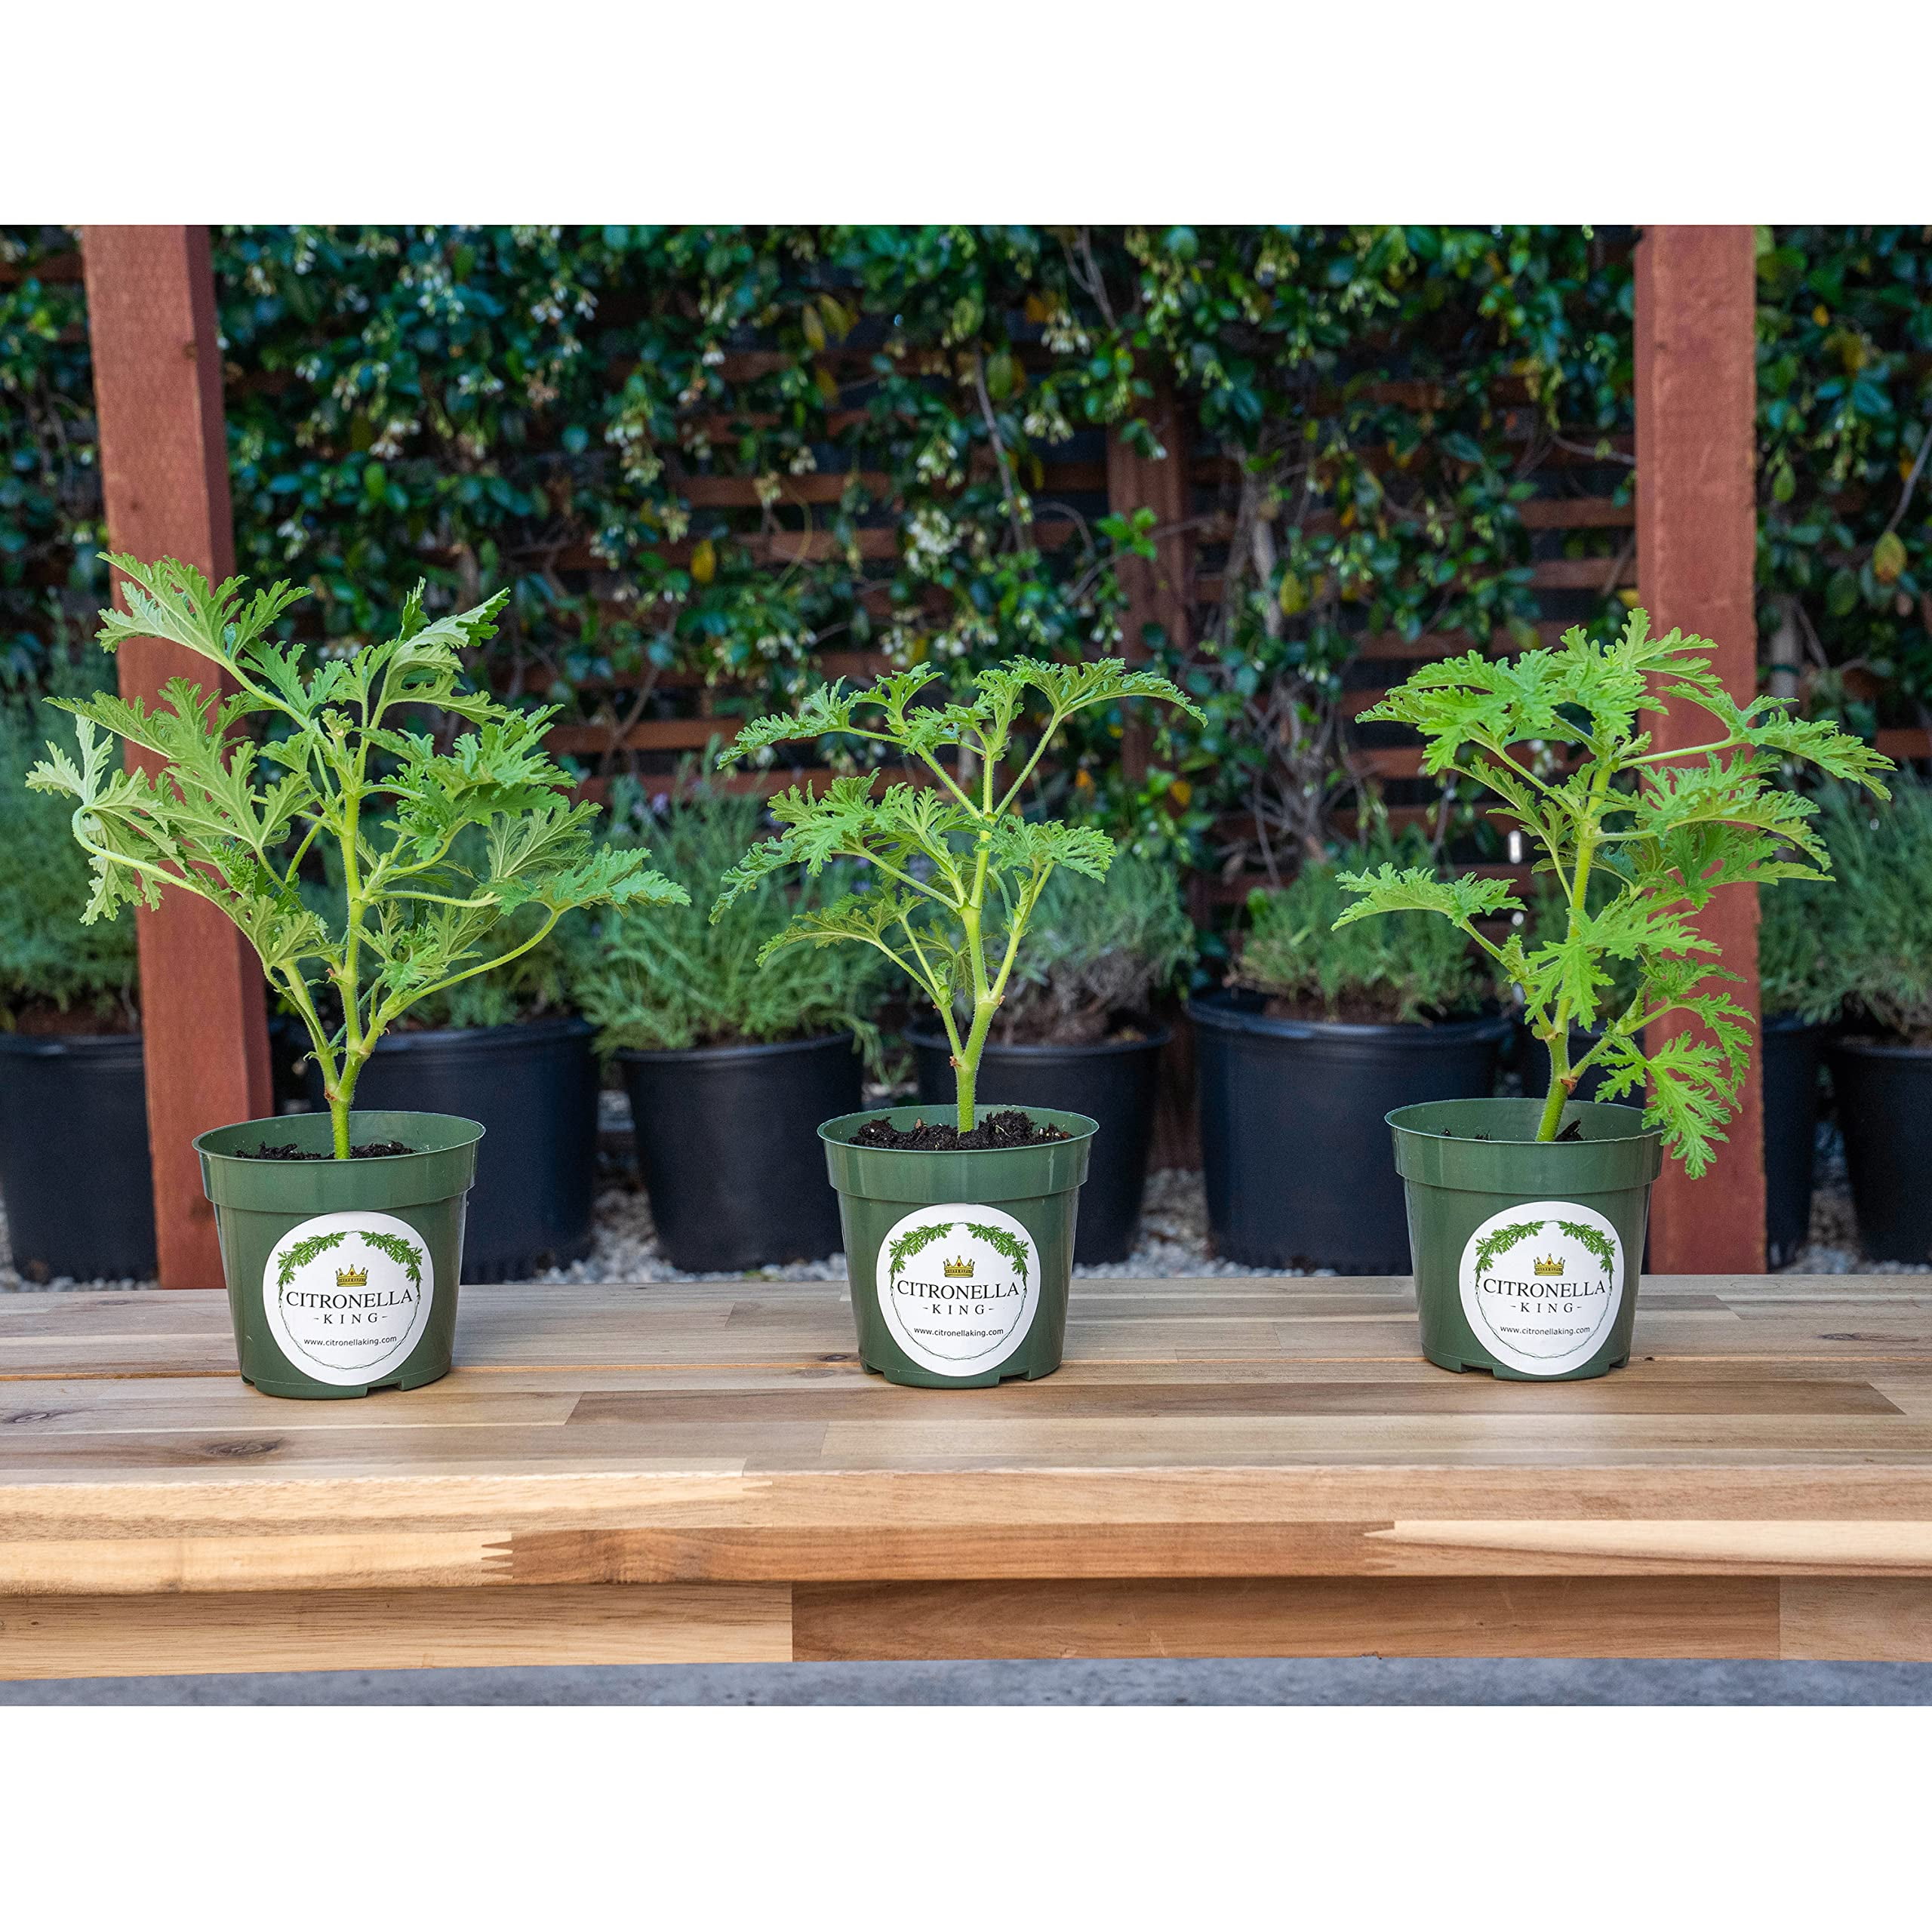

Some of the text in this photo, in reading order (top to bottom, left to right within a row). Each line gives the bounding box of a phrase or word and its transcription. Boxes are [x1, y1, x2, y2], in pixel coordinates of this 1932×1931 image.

[897, 1279, 1019, 1299] CITRONELLA
[1484, 1278, 1605, 1297] CITRONELLA
[287, 1288, 413, 1308] CITRONELLA
[913, 1327, 1004, 1338] www.citronellaking.com
[1500, 1325, 1590, 1336] www.citronellaking.com
[303, 1336, 397, 1347] www.citronellaking.com
